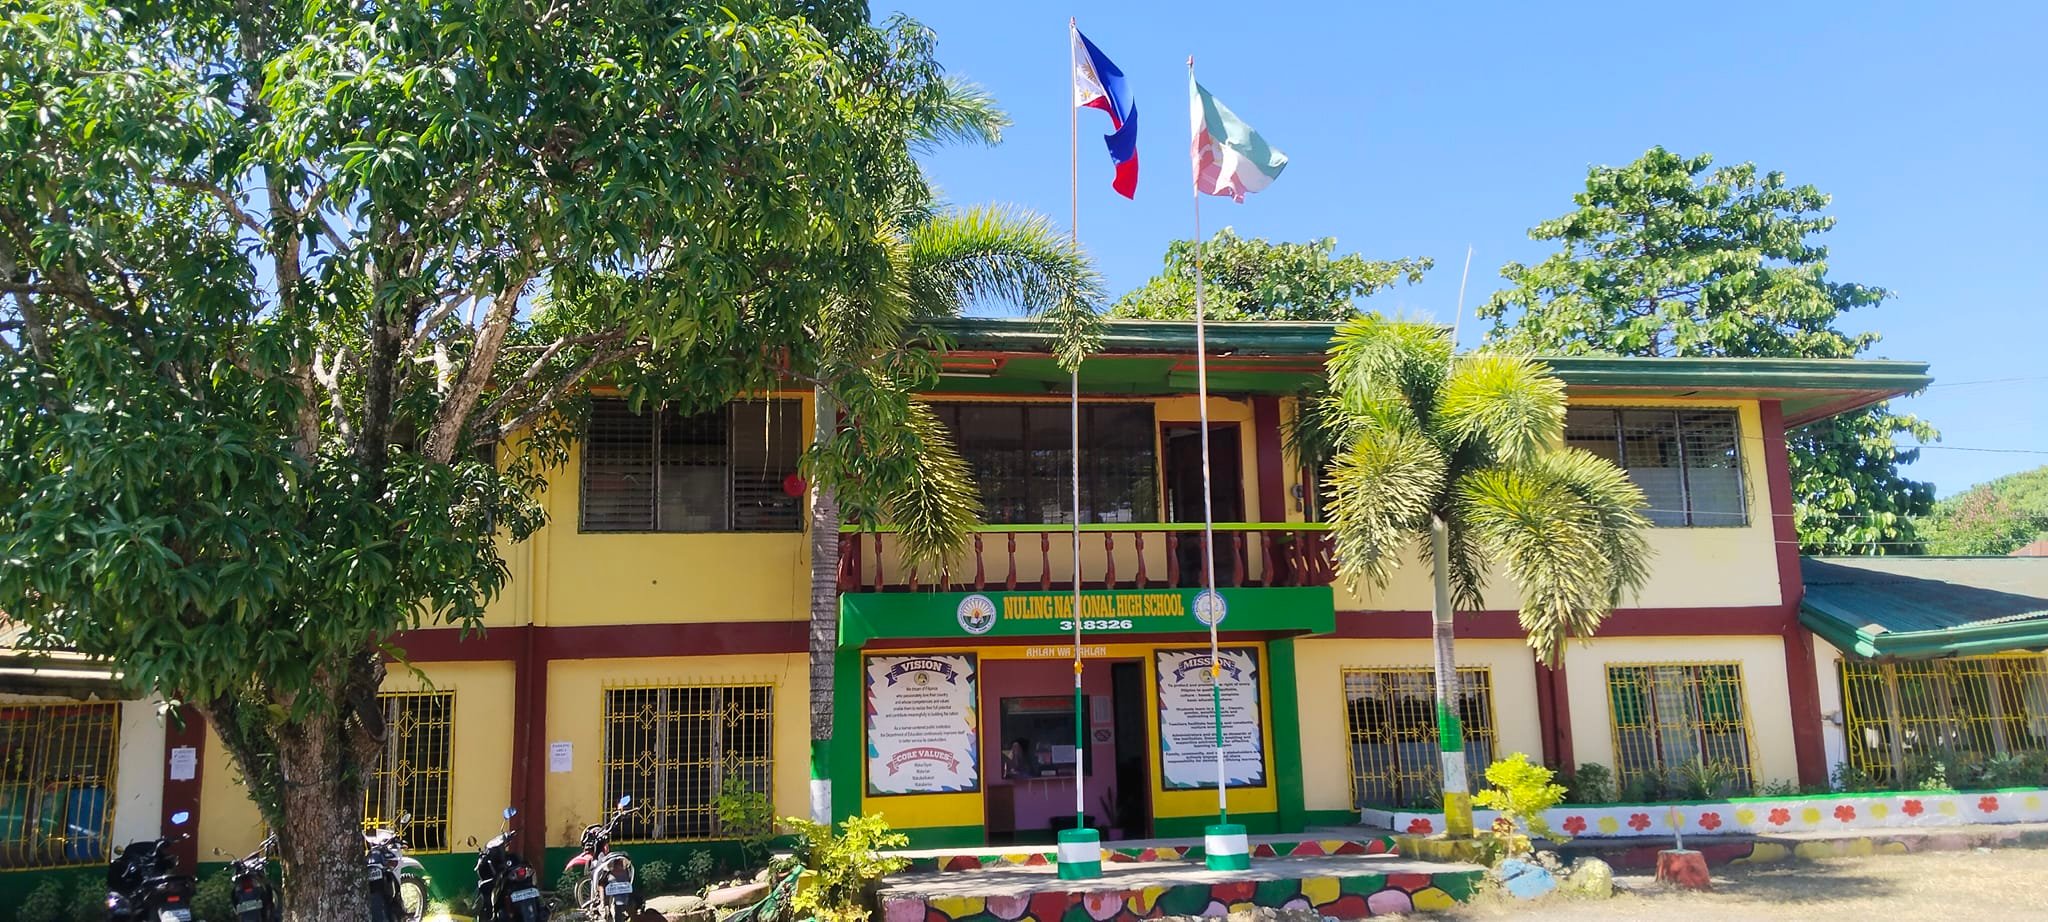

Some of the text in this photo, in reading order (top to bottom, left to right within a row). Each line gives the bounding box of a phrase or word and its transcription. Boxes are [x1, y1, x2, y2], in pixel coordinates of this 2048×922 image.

[1003, 595, 1053, 619] NULING
[1116, 594, 1143, 617] HIGH
[1144, 593, 1185, 616] SCHOOL
[1026, 646, 1107, 657] AHLAN WA AHLAN
[901, 660, 943, 671] VISION
[1183, 657, 1231, 669] MISSON
[897, 750, 950, 762] CORE VALUES
